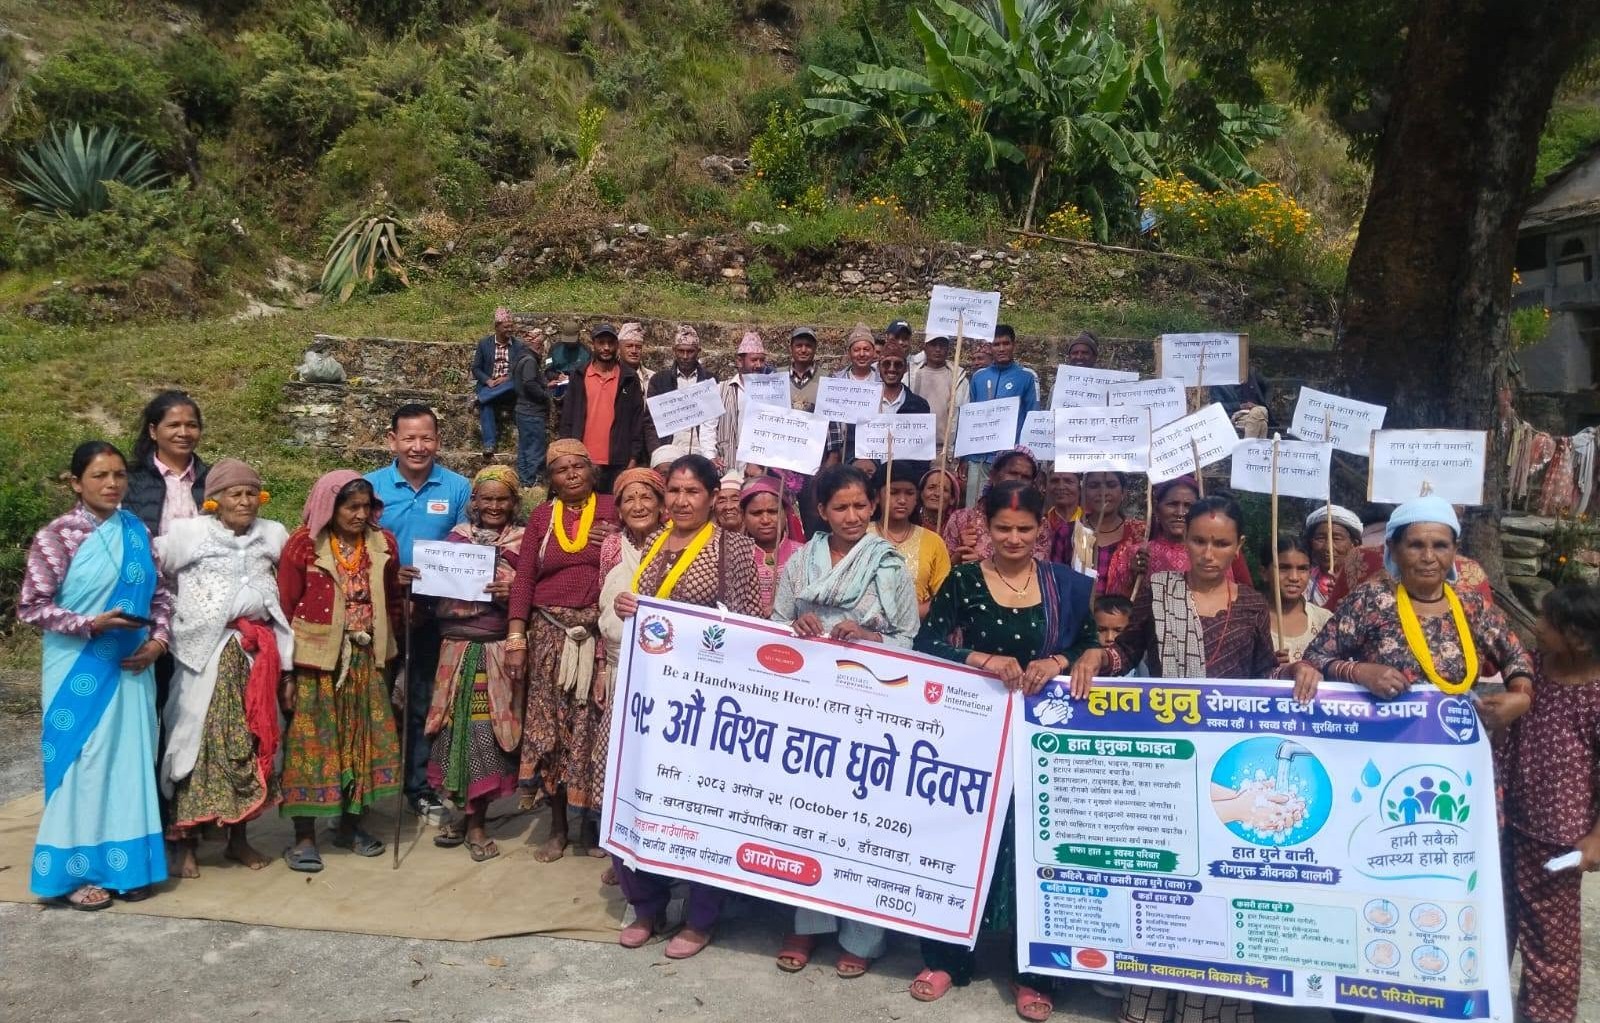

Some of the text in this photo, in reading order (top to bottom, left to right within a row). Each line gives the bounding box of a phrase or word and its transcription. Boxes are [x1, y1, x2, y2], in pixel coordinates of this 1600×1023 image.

[1308, 399, 1321, 408] हात
[1109, 414, 1140, 429] सुरक्षित
[1068, 433, 1136, 443] परिवार स्वस्थ
[1389, 441, 1405, 451] हात
[1067, 452, 1106, 461] समाजको
[1247, 448, 1260, 456] हात
[662, 664, 680, 679] Be
[682, 671, 690, 681] a
[694, 670, 780, 703] Handwashing
[783, 690, 819, 709] Hero!
[823, 699, 851, 715] (हात
[854, 703, 874, 725] धुने
[875, 711, 912, 730] नायक
[946, 685, 979, 701] Malteser
[944, 695, 993, 713] International
[1086, 686, 1429, 725] हात धुनु रोगबाट सरल उपाय
[1311, 720, 1342, 734] सुरक्षित
[631, 692, 655, 735] १९
[710, 695, 778, 764] विश्व
[781, 726, 842, 780] हात
[846, 733, 900, 800] धुने
[905, 739, 993, 815] दिवस
[1066, 738, 1177, 756] हात धुनुका फाइदा
[656, 763, 683, 782] मिति
[697, 775, 726, 793] २०८३
[732, 783, 765, 800] असोज
[789, 796, 848, 821] (October
[852, 811, 871, 829] 15,
[875, 816, 912, 838] 2026)
[728, 809, 789, 836] गाउँपालिका
[793, 825, 814, 840] वडा
[857, 838, 912, 867] डाँडावाडा,
[1390, 829, 1458, 850] हामी सबैको
[642, 836, 733, 866] स्थानीय परियोजना
[1069, 845, 1086, 855] सफा
[1088, 846, 1101, 856] हात
[1114, 849, 1135, 859] स्वस्थ
[1137, 849, 1161, 860] परिवार
[1231, 845, 1319, 865] हात धुने बानी,
[1367, 848, 1449, 869] स्वास्थ्य हाम्रो
[742, 847, 806, 876] आयोजक
[1113, 858, 1135, 869] समृद्ध
[1136, 860, 1159, 870] समाज
[1060, 871, 1085, 883] कहिले,
[1110, 874, 1133, 887] कसरी
[1133, 878, 1148, 888] हात
[1149, 878, 1164, 890] धुने
[1219, 862, 1299, 881] रोगमुक्त जीवनको
[833, 866, 967, 911] ग्रामीण स्वावलम्बन केन्द्र
[875, 893, 917, 918] (RSDC)
[1115, 959, 1270, 990] ग्रामीण स्वावलम्बन केन्द्र
[1340, 982, 1446, 1010] LACC परियोजना
